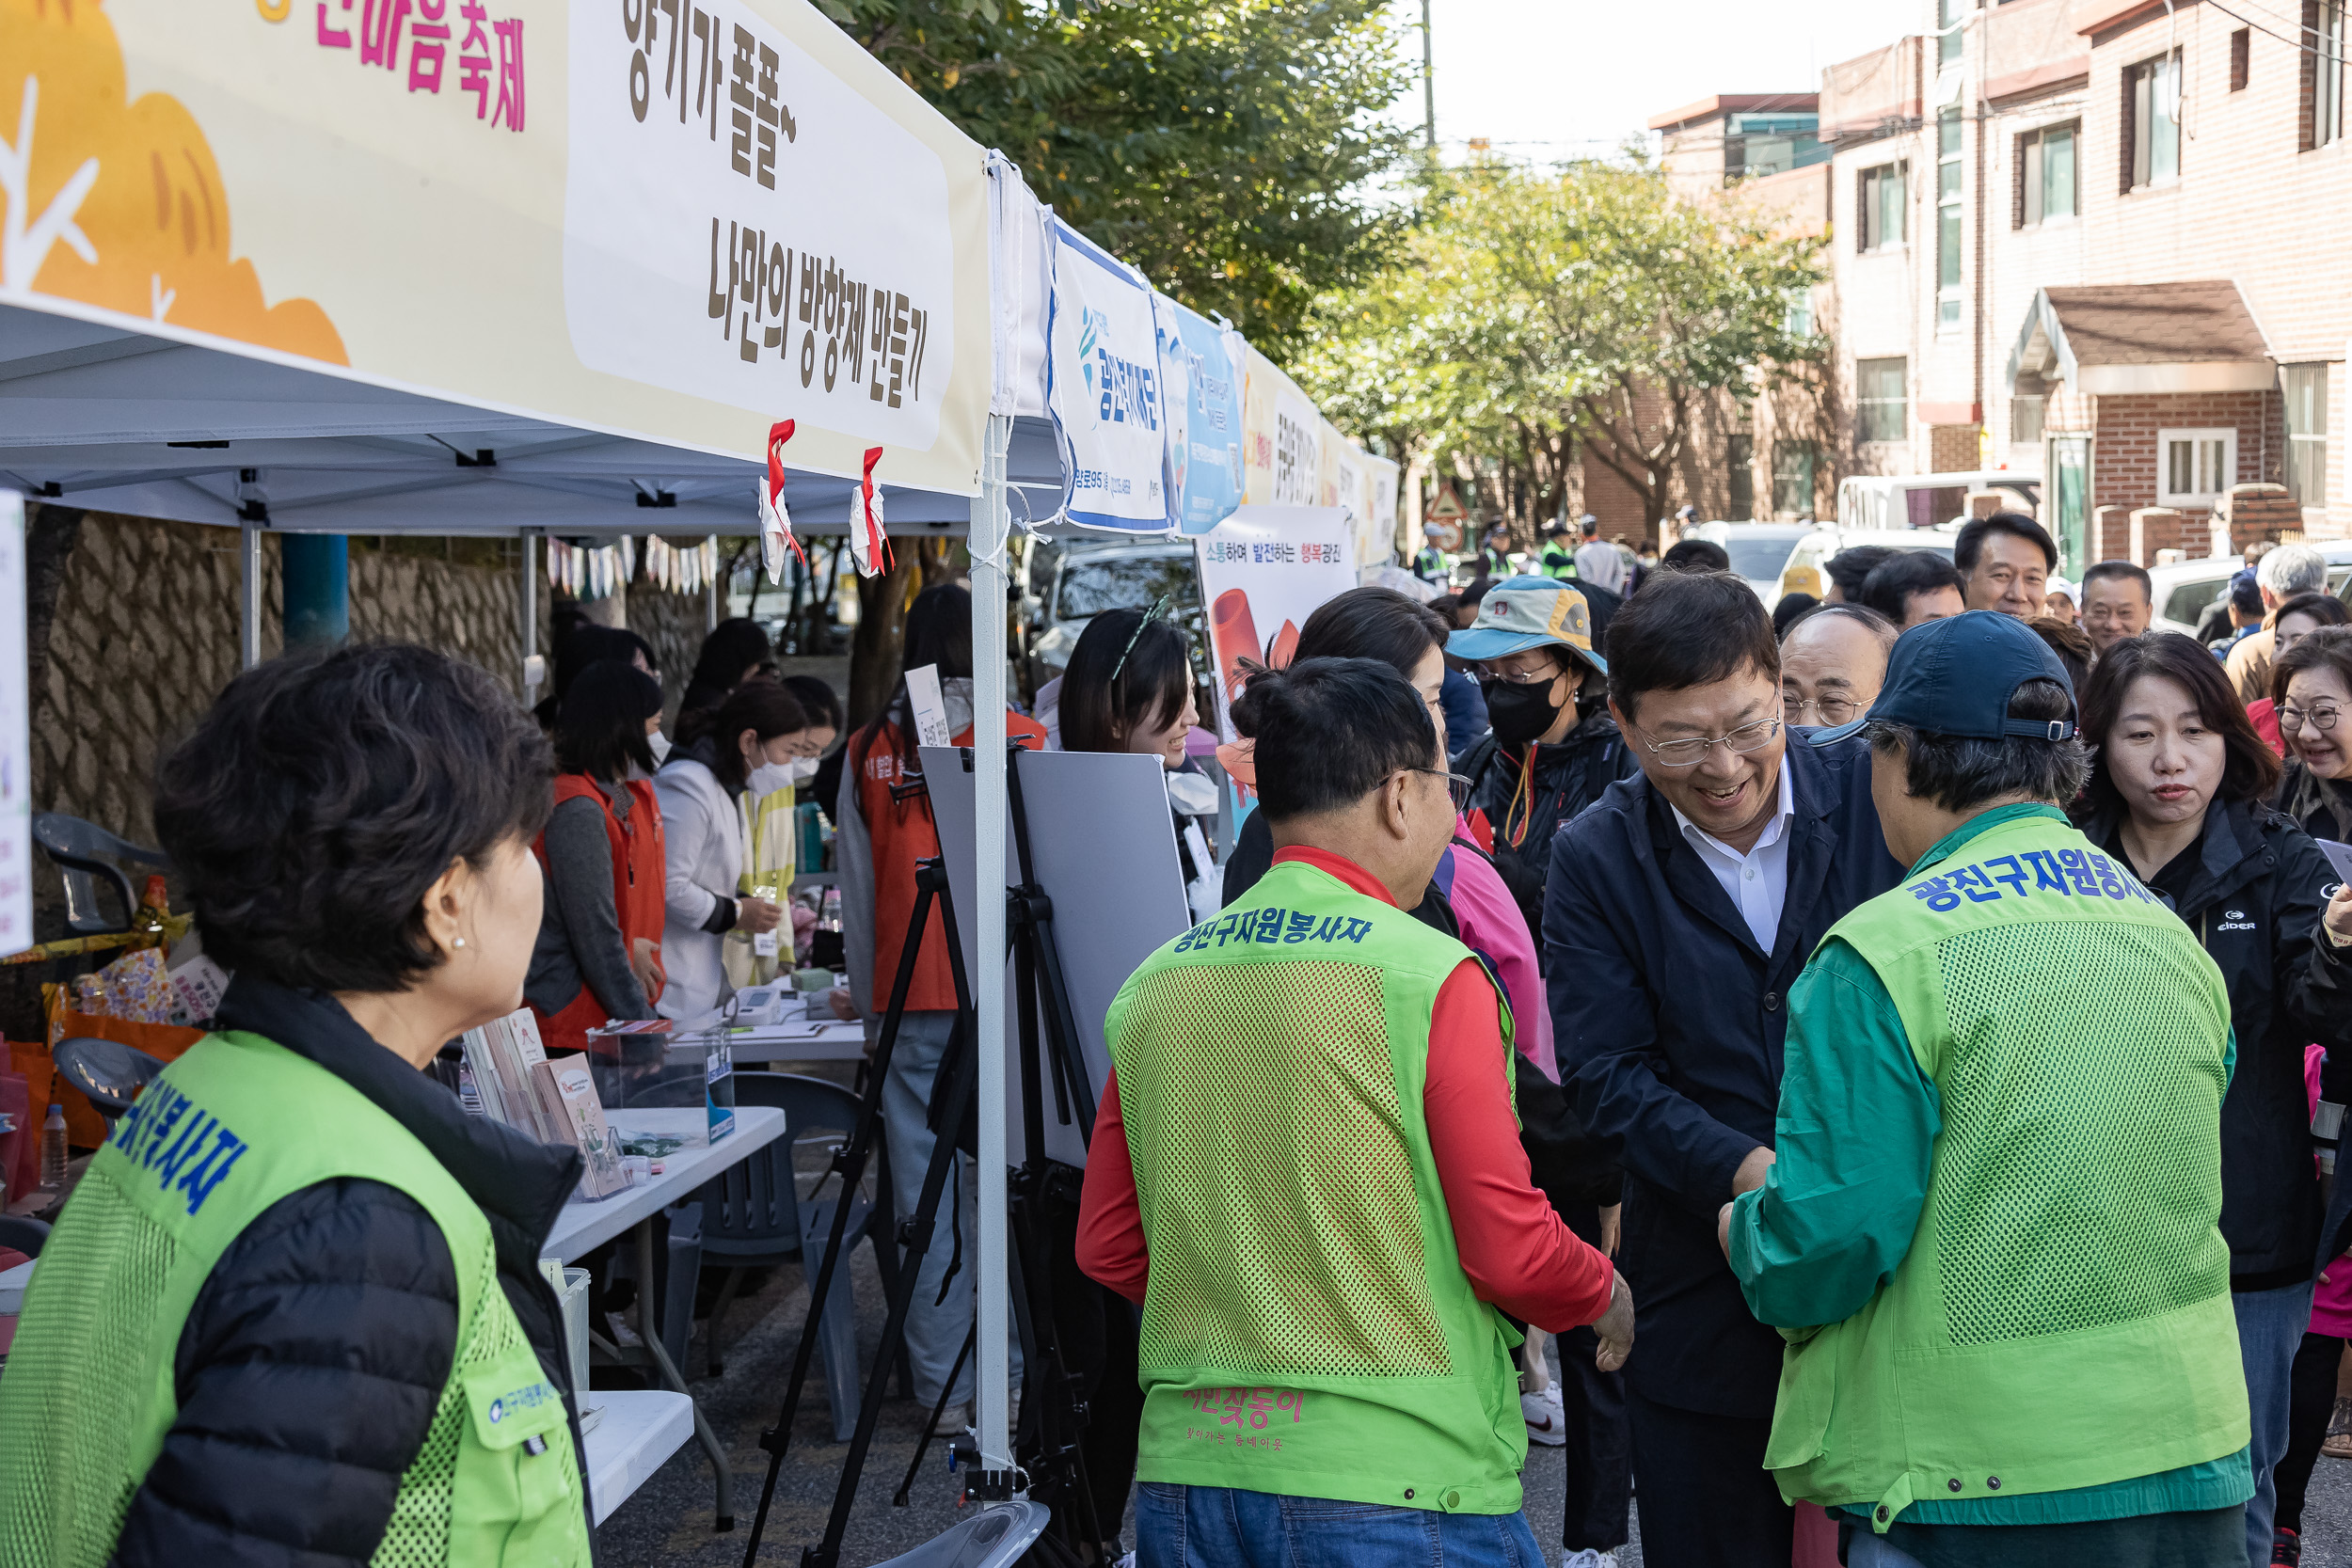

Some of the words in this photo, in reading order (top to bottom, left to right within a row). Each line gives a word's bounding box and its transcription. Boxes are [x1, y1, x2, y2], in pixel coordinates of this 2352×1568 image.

[707, 217, 793, 364] 나만의
[799, 252, 867, 393] 방향제
[870, 289, 928, 409] 만들기
[1207, 542, 1248, 563] 소통하며
[1253, 543, 1295, 563] 발전하는
[1301, 543, 1342, 563] 행복광진
[1174, 908, 1374, 953] 광진구자원봉사자
[1187, 1427, 1226, 1445] 찾아가는
[1234, 1434, 1283, 1451] 동네이웃
